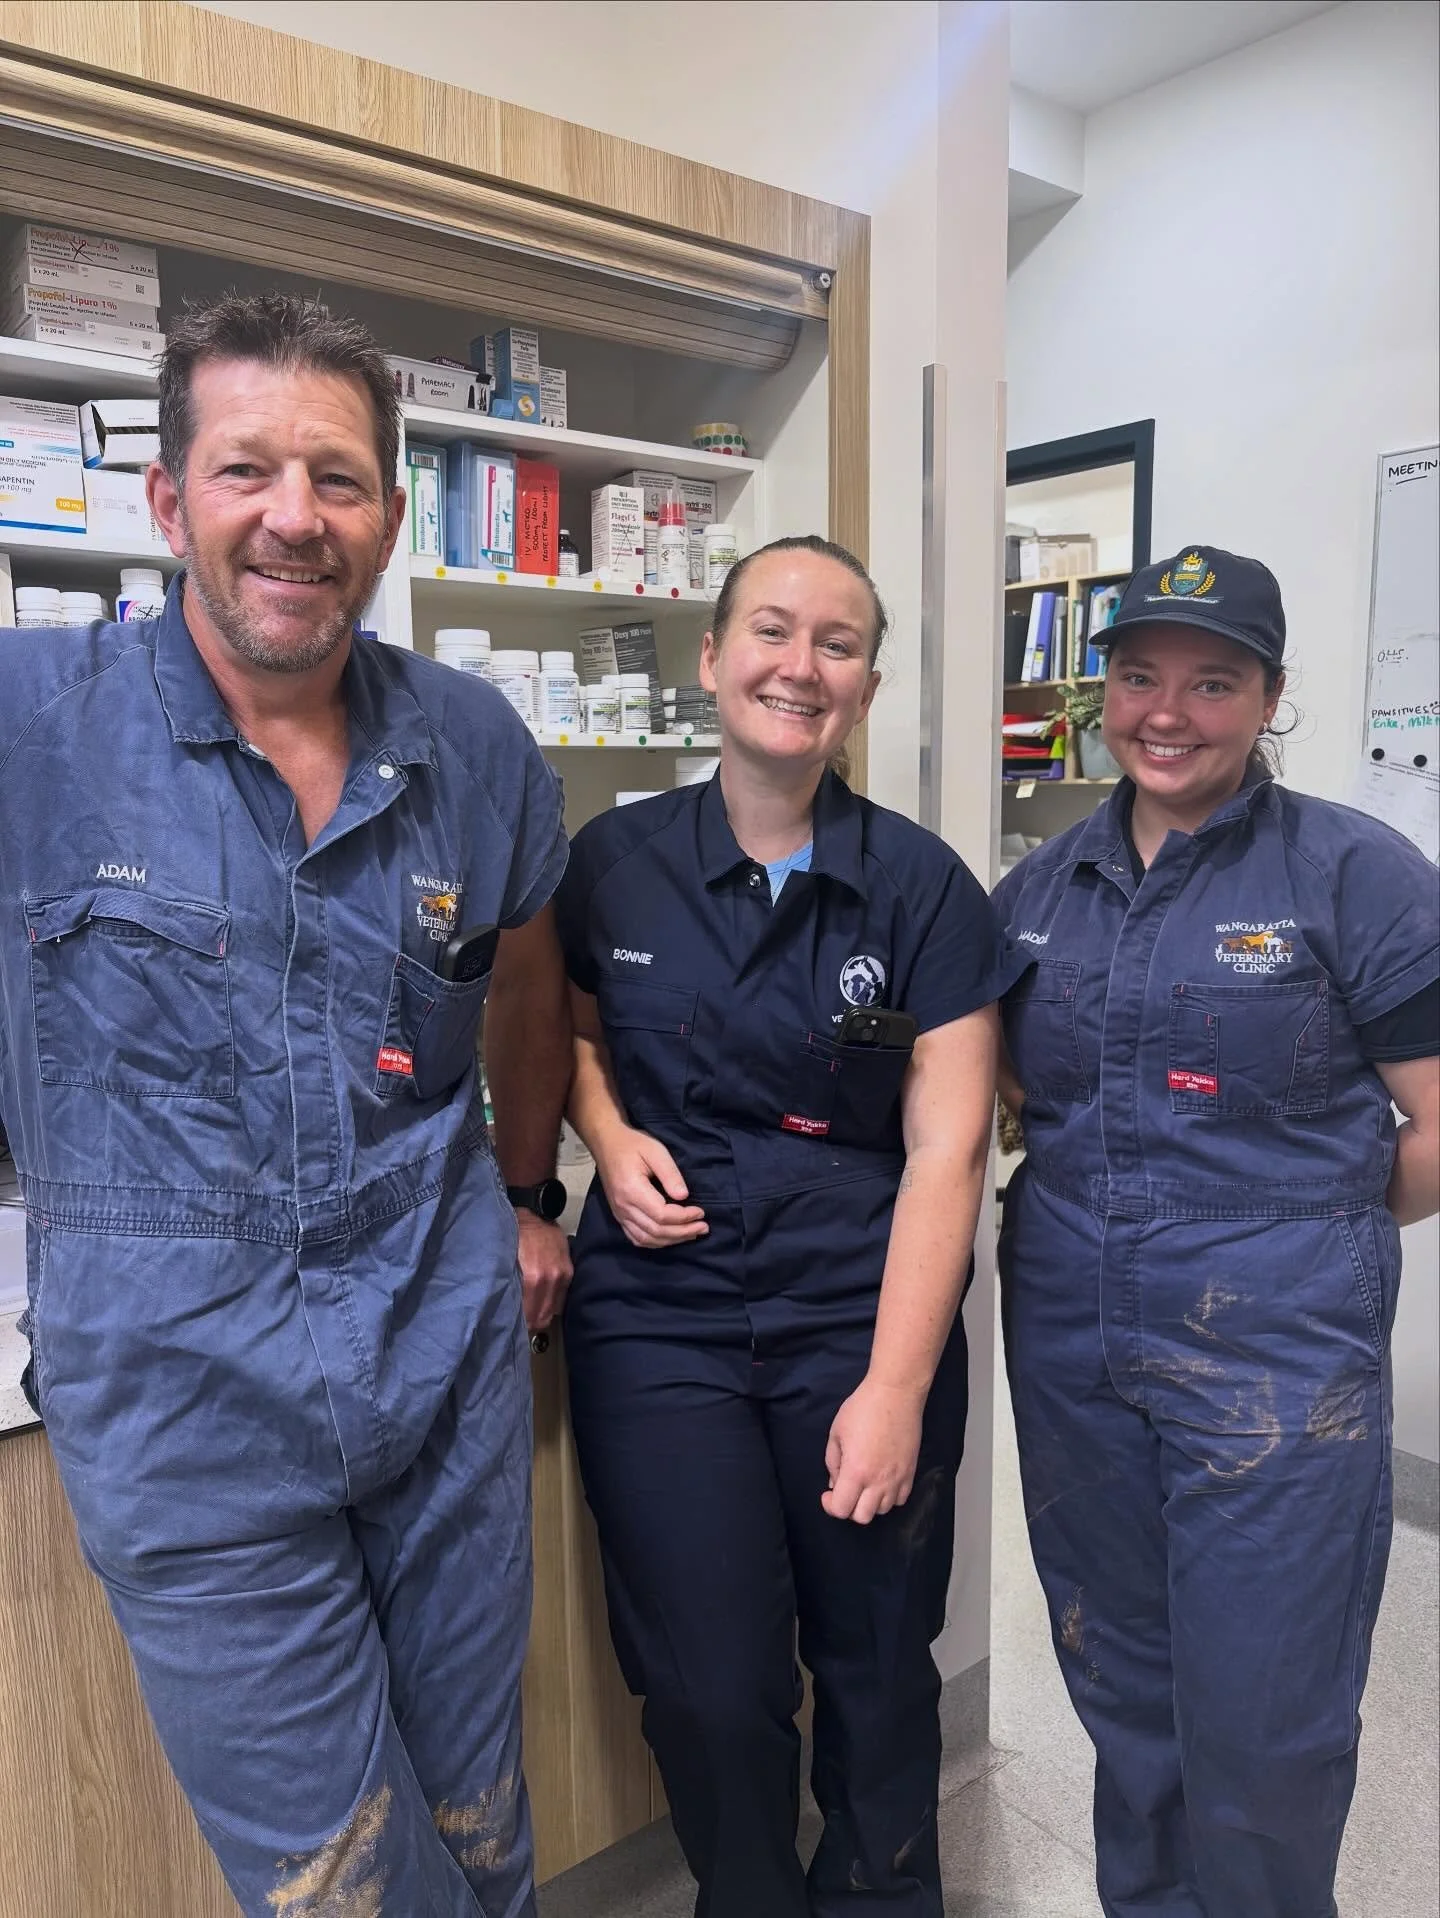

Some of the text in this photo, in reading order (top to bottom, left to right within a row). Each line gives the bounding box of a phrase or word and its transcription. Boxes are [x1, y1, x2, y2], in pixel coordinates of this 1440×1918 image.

[28, 287, 117, 310] Propofol-Lipuro 1%
[611, 513, 630, 522] Flagyl
[614, 631, 629, 640] Doxy
[1371, 705, 1429, 718] PAWSITIVES
[96, 863, 146, 883] ADAM
[1215, 918, 1296, 933] WANGARATTA
[613, 948, 654, 964] BONNIE
[1215, 952, 1294, 963] VETERINARY
[1233, 963, 1276, 974] CLINIC
[1171, 1073, 1190, 1081] Hard
[789, 1116, 806, 1126] Hard
